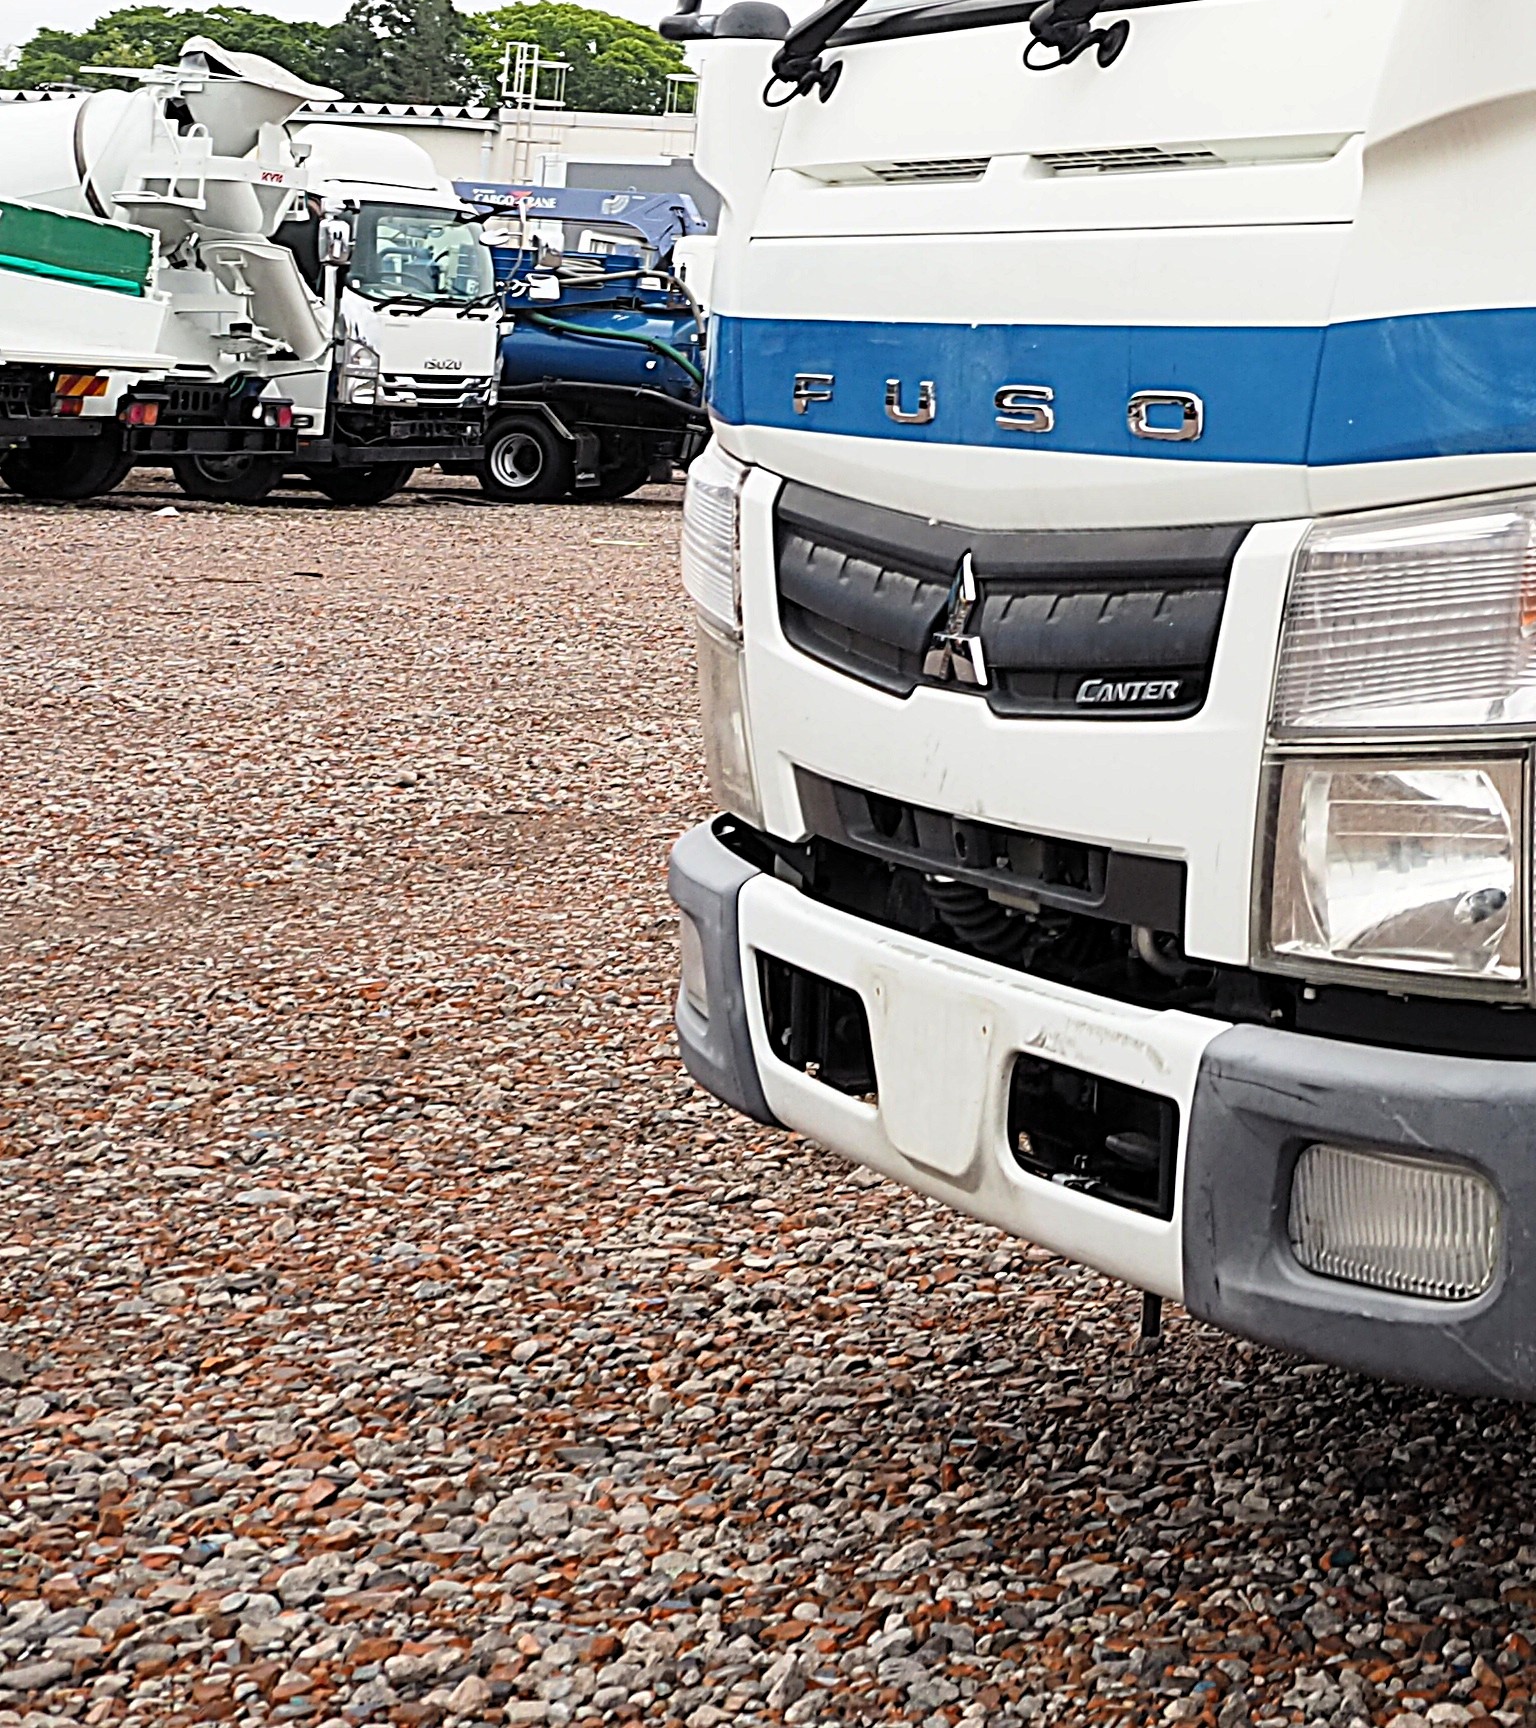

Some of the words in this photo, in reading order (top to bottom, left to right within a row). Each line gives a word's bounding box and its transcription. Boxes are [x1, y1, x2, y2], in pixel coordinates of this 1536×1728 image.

[474, 193, 515, 206] CARGO
[423, 358, 463, 370] ISUZU
[792, 373, 1204, 441] FUSO
[1075, 677, 1182, 703] CANTER
